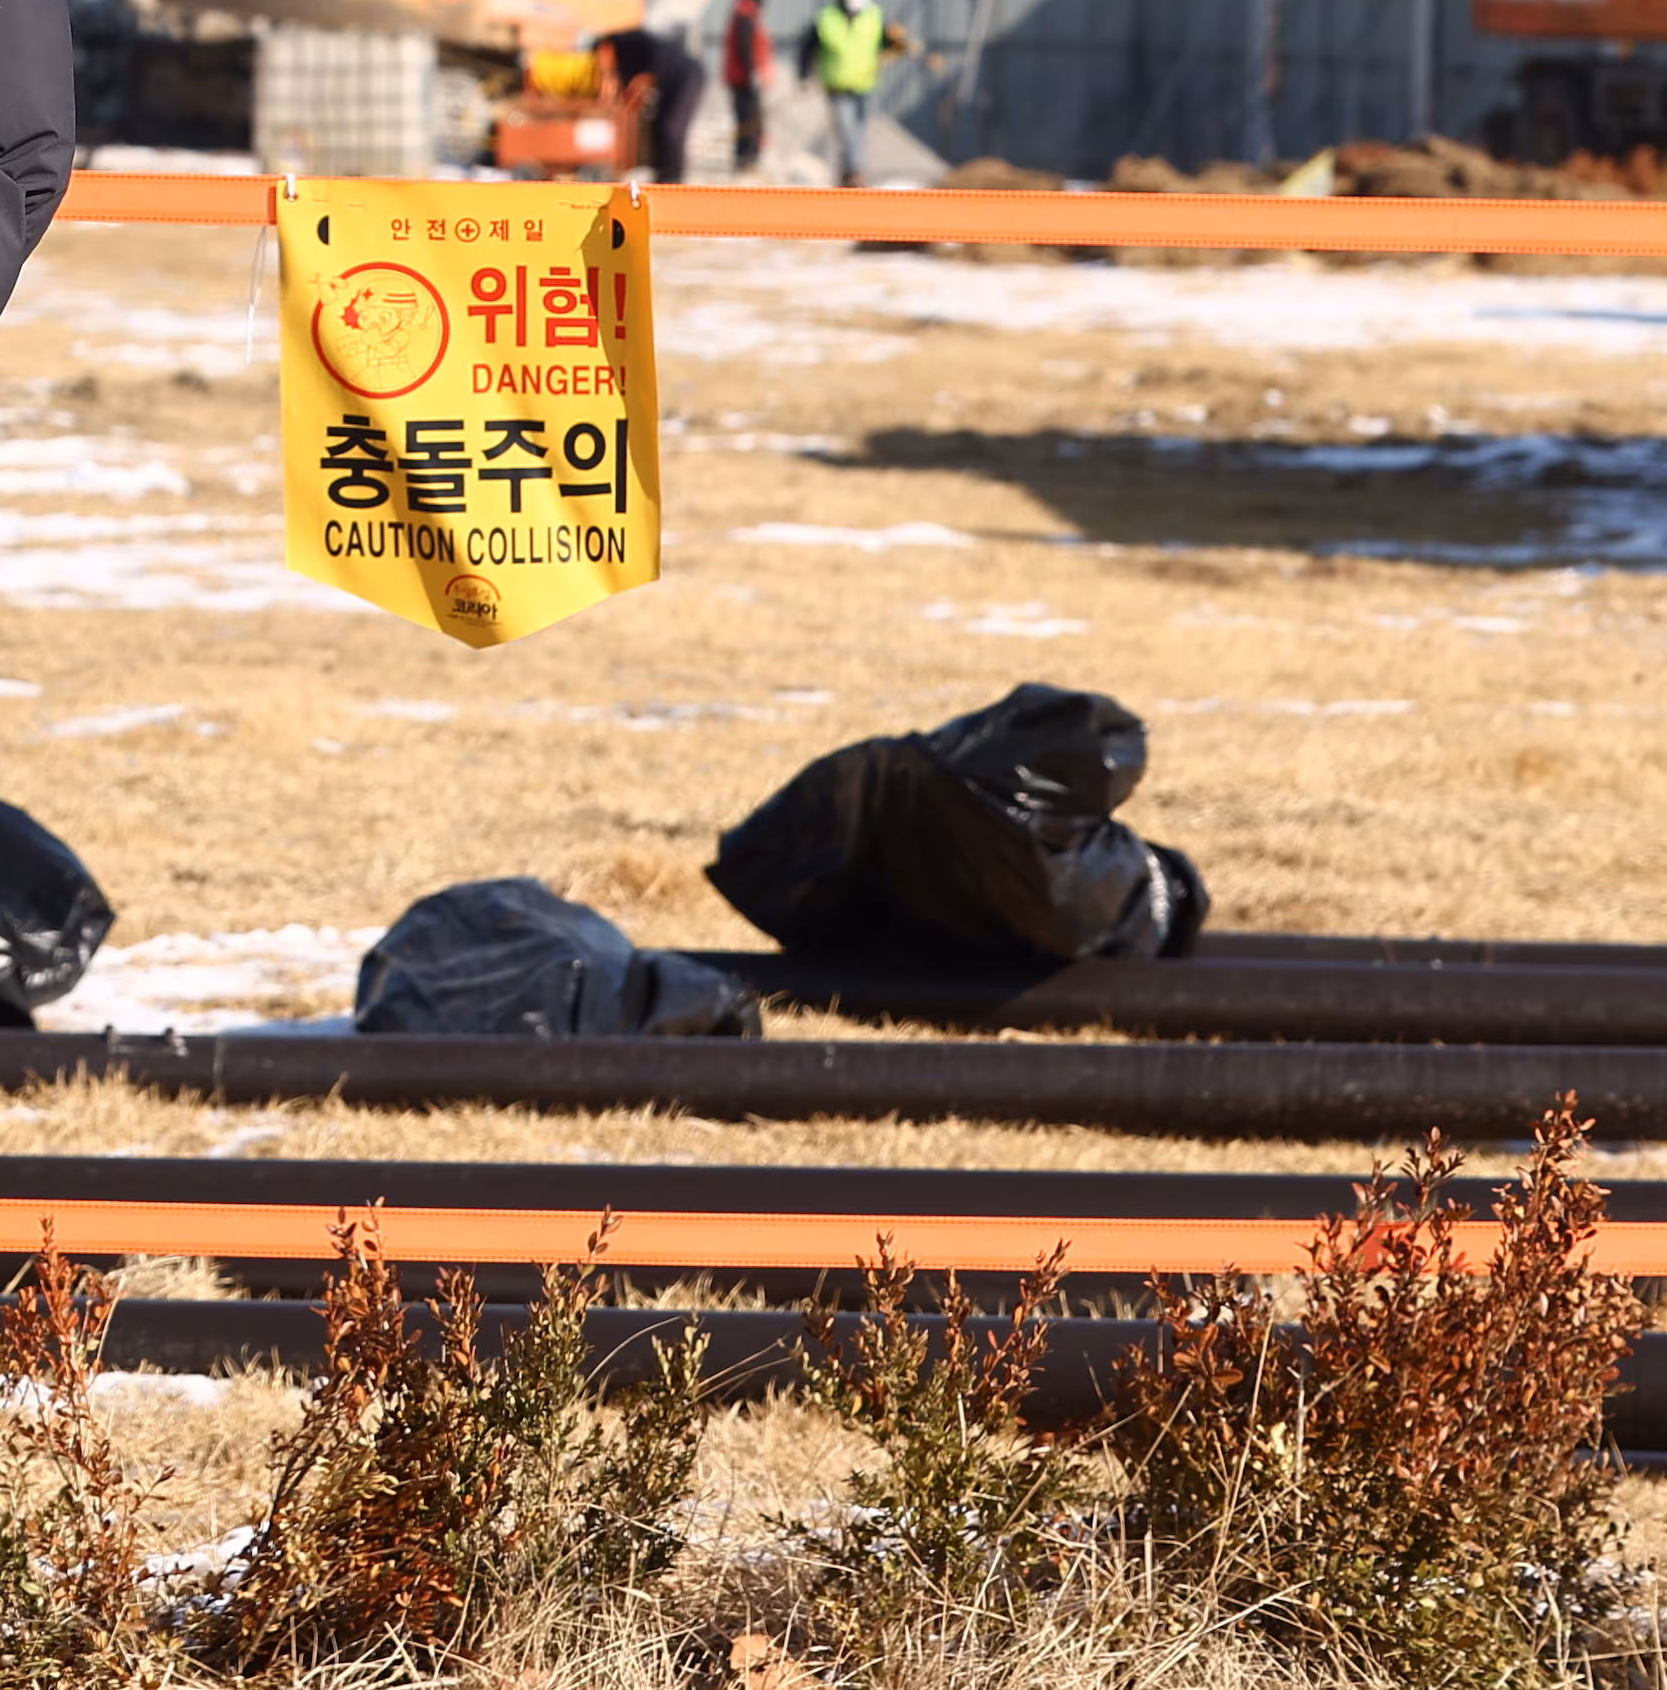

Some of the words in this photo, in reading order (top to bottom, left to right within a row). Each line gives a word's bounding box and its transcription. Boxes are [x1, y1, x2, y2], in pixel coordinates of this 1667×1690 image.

[467, 265, 628, 349] 위험!
[472, 364, 627, 396] DANGER!
[320, 414, 630, 515] 충돌주의
[324, 519, 455, 565] CAUTION
[467, 524, 626, 566] COLLISION
